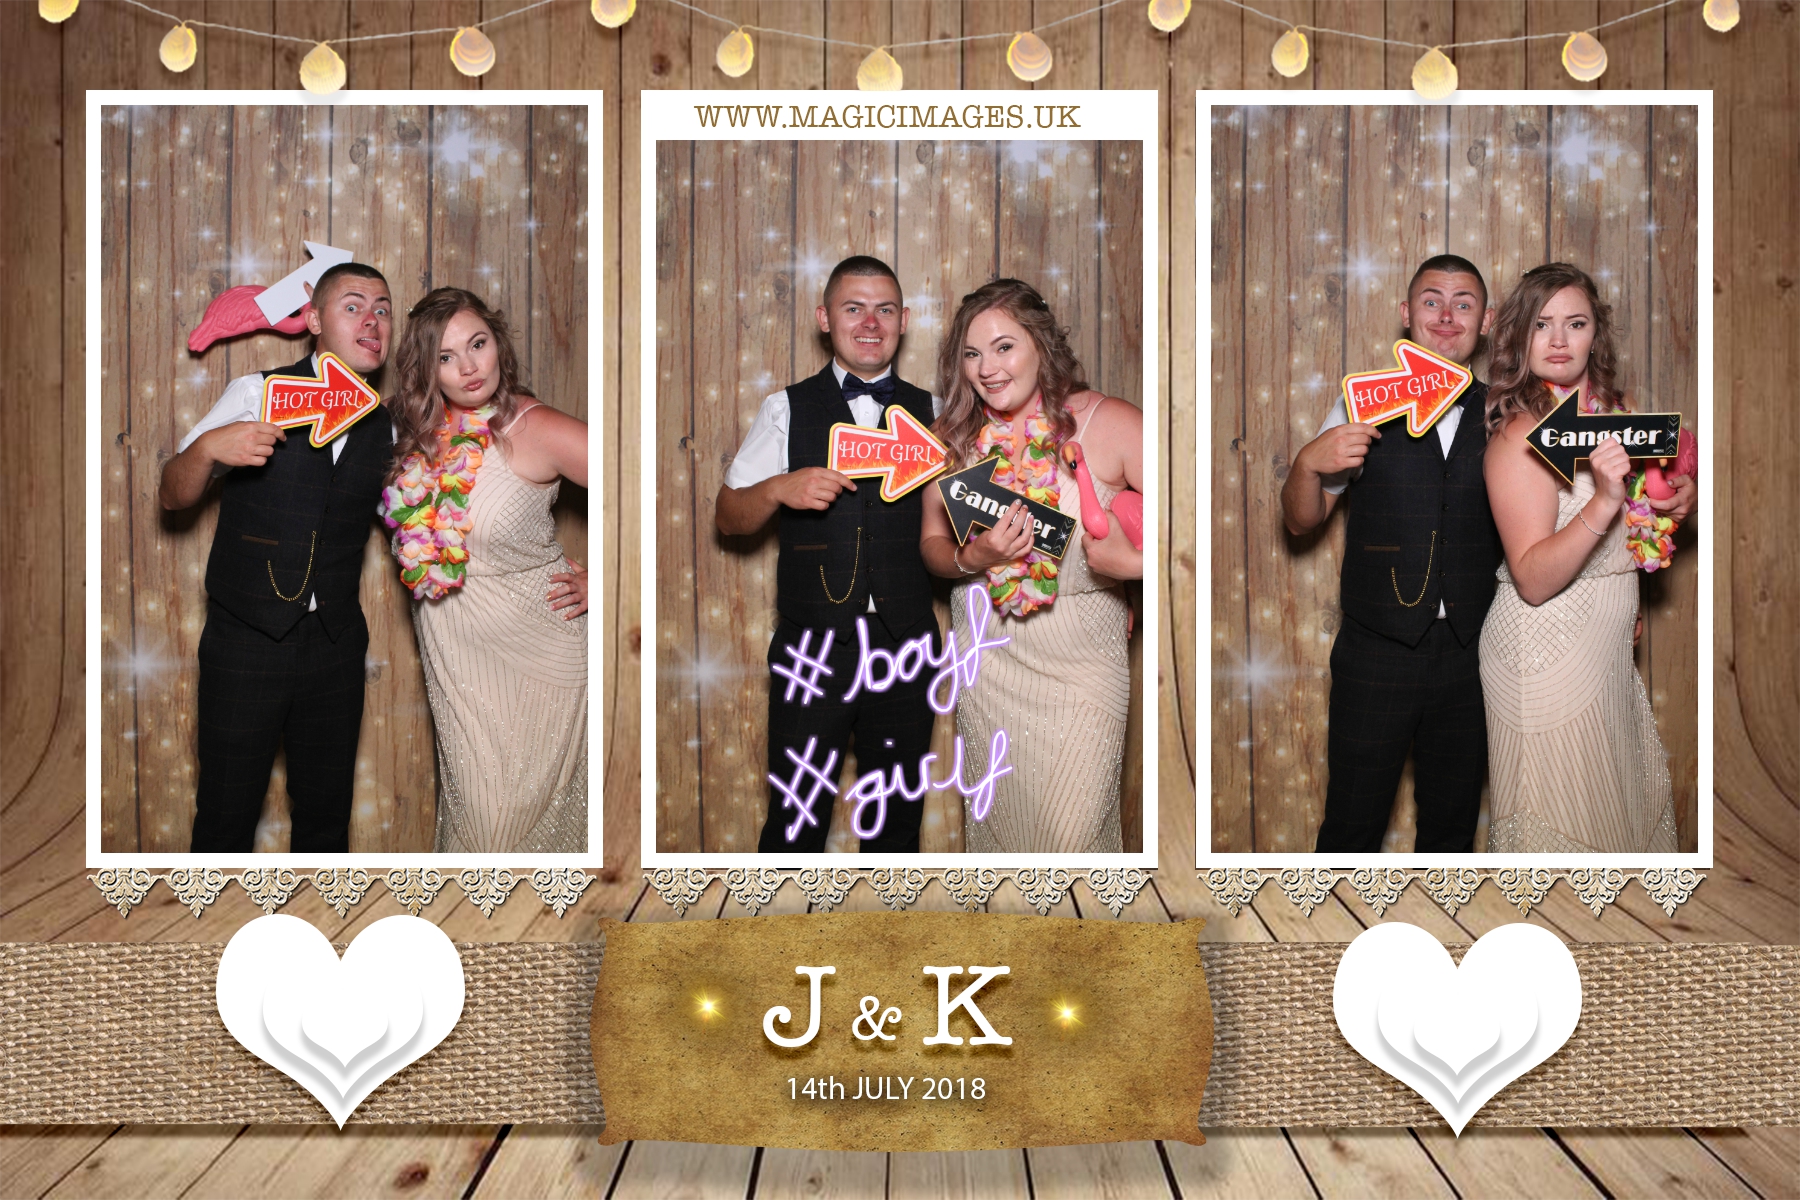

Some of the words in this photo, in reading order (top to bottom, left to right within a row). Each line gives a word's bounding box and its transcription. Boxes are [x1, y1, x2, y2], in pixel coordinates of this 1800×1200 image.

[272, 391, 319, 410] HOT
[320, 389, 363, 411] GIRL
[1355, 381, 1403, 408] HOT
[1407, 370, 1456, 398] GIRL
[839, 440, 887, 460] HOT
[890, 443, 937, 466] GIRL
